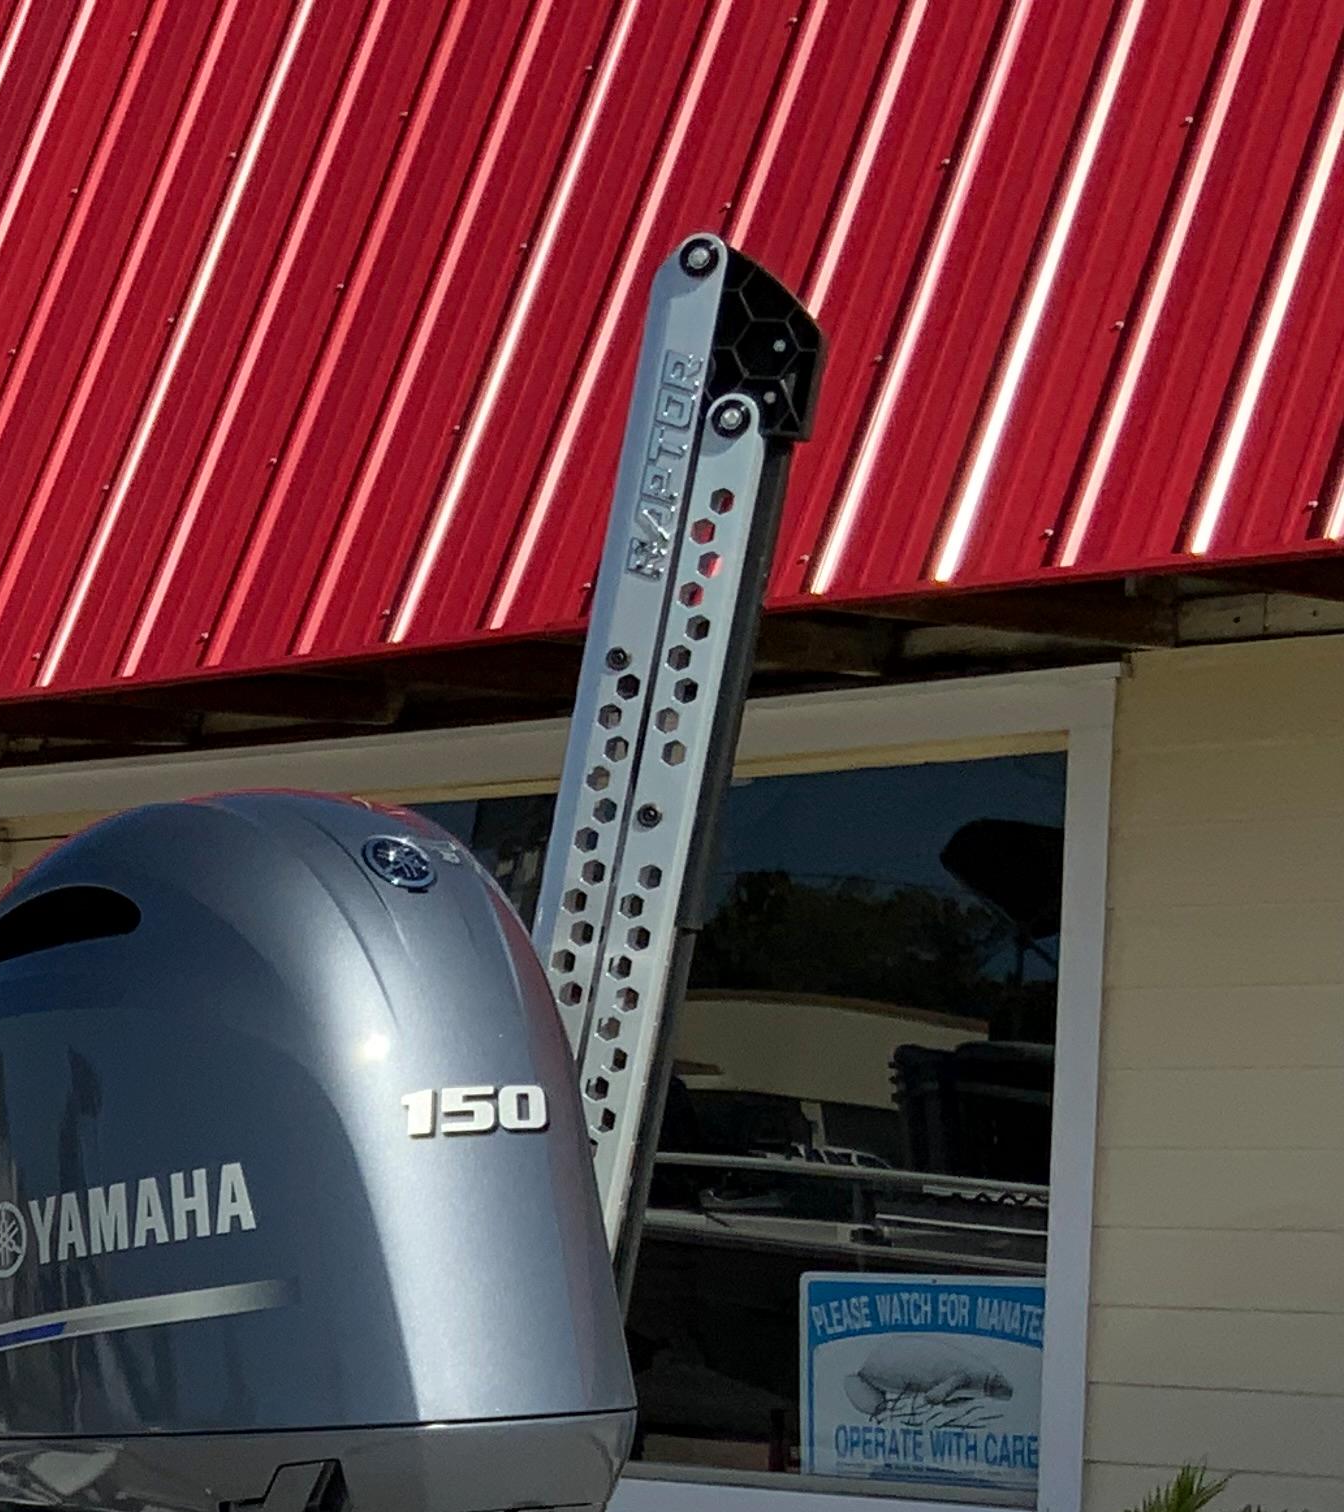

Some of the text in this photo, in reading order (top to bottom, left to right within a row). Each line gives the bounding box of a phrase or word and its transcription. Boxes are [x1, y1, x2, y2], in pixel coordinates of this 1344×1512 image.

[400, 1085, 550, 1138] 150
[29, 1162, 257, 1264] YAMAHA
[811, 1296, 872, 1336] PLEASE
[876, 1291, 933, 1326] WATCH
[938, 1293, 970, 1327] FOR
[834, 1424, 1040, 1469] OPERATE WITH CARE
